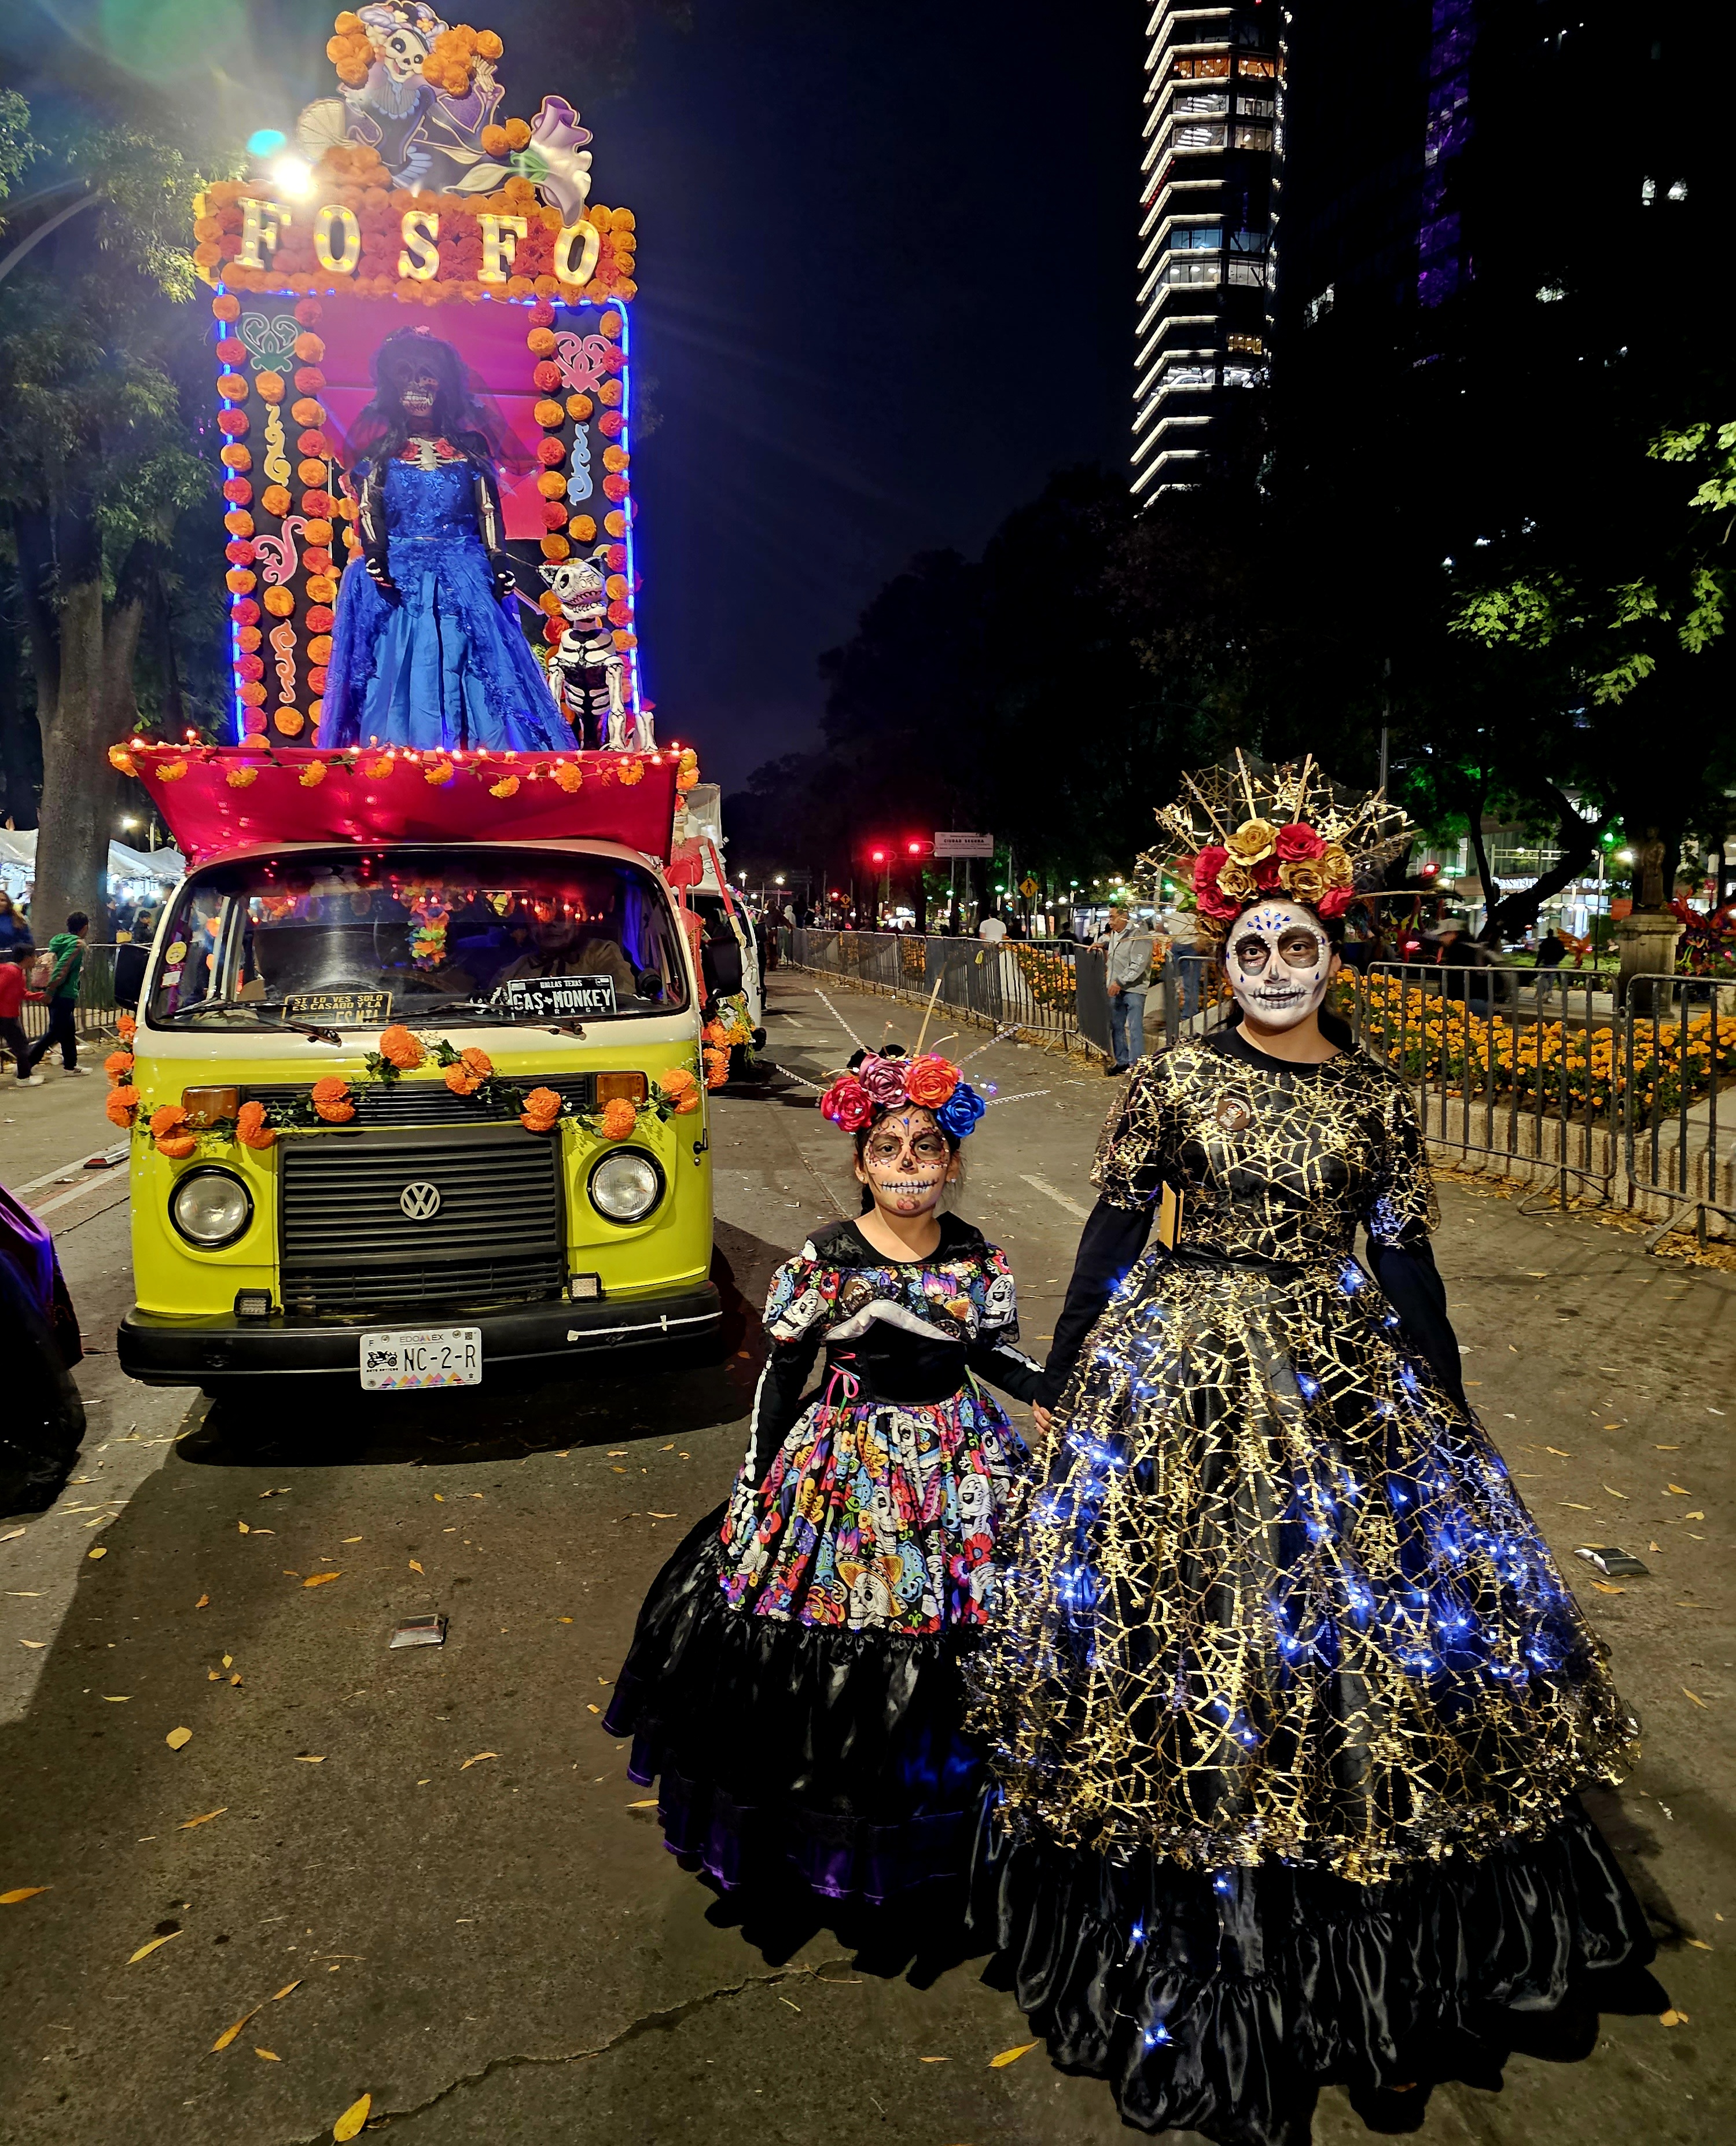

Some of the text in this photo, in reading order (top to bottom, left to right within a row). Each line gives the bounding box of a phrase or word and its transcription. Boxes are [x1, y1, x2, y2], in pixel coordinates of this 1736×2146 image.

[233, 197, 600, 285] FOSFO
[310, 1002, 354, 1010] CASADO
[551, 989, 611, 1009] MONKEY
[404, 1344, 476, 1372] NC-2-R
